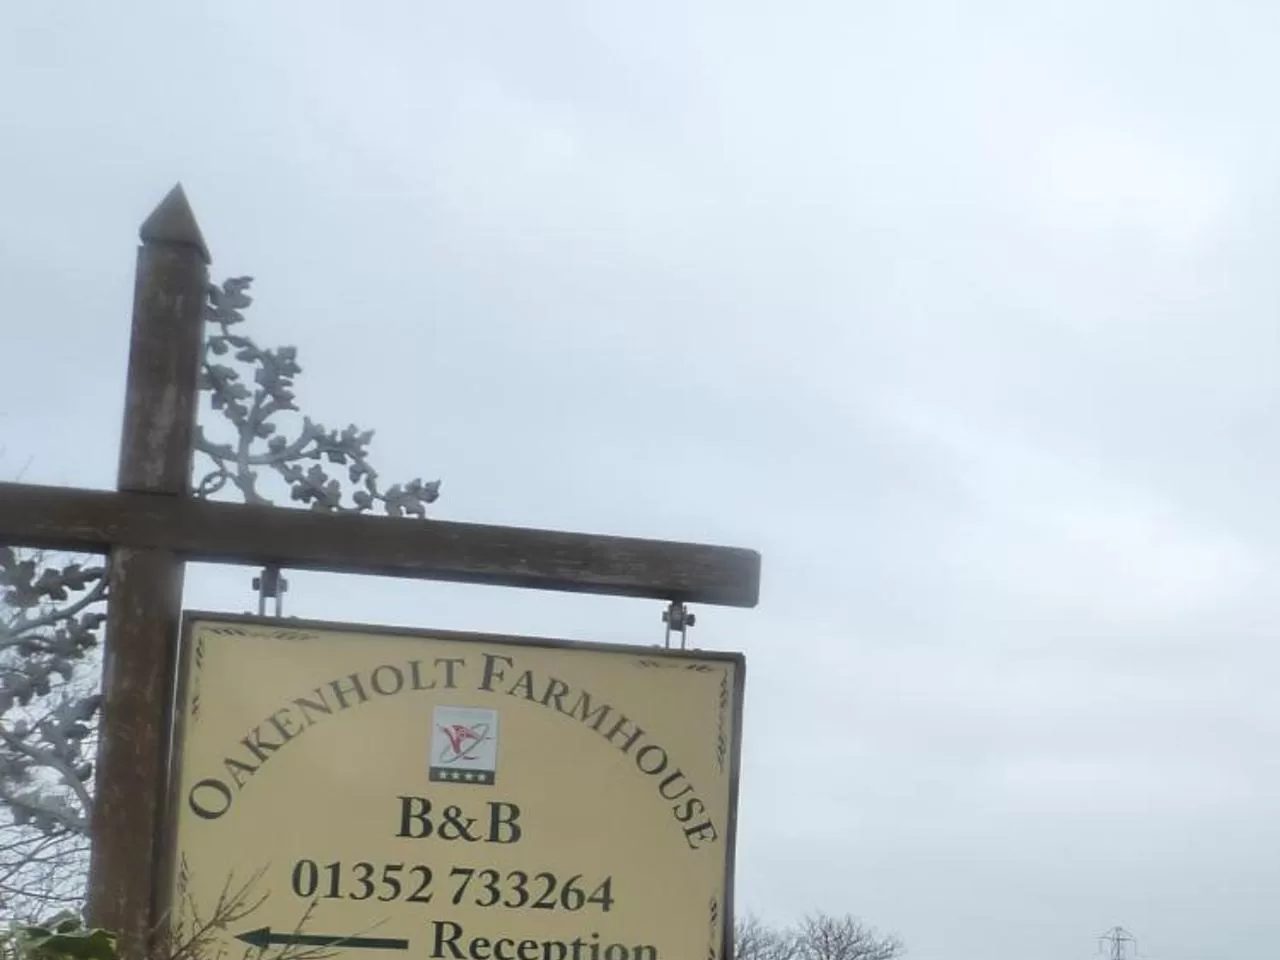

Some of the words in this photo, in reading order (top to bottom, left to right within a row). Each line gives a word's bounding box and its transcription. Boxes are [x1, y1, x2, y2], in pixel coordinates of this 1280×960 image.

[188, 657, 466, 820] OAKENHOLT
[476, 653, 719, 850] FARMHOUSE
[395, 796, 522, 844] B&B
[292, 859, 433, 902] 01352
[449, 867, 615, 912] 733264
